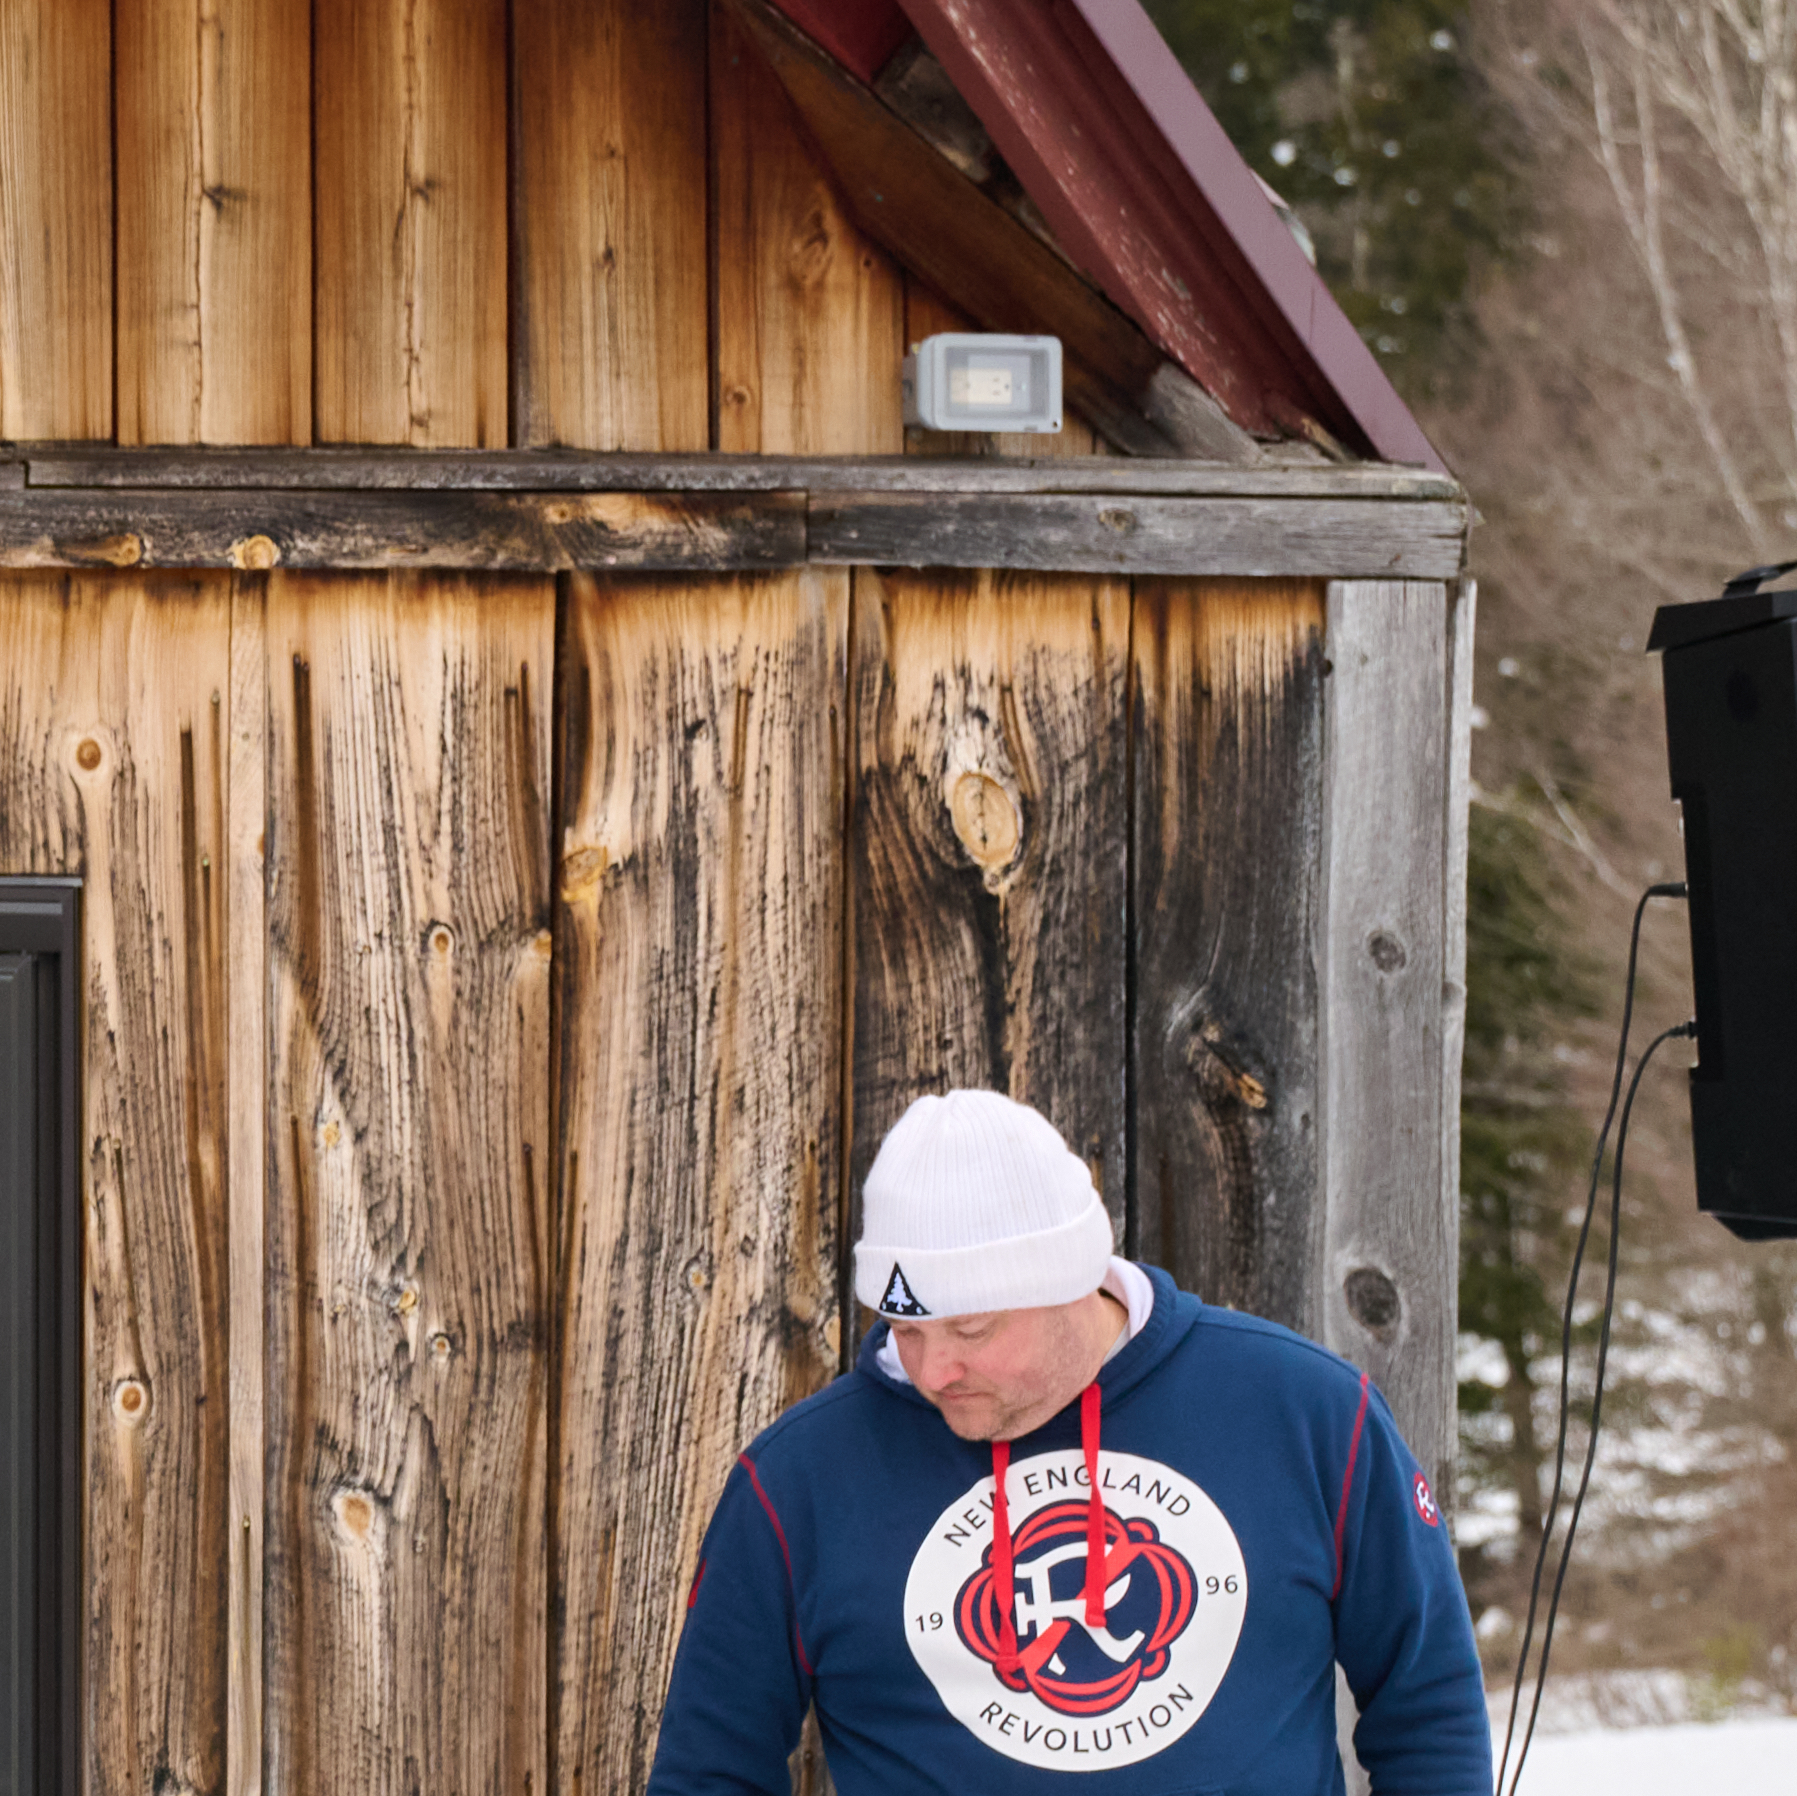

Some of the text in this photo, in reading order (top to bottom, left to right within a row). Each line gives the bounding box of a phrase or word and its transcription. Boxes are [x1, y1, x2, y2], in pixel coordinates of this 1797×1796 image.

[1023, 1464, 1192, 1518] ENGLAND
[915, 1575, 1239, 1633] 19 96
[978, 1682, 1194, 1753] REVOLUTION
